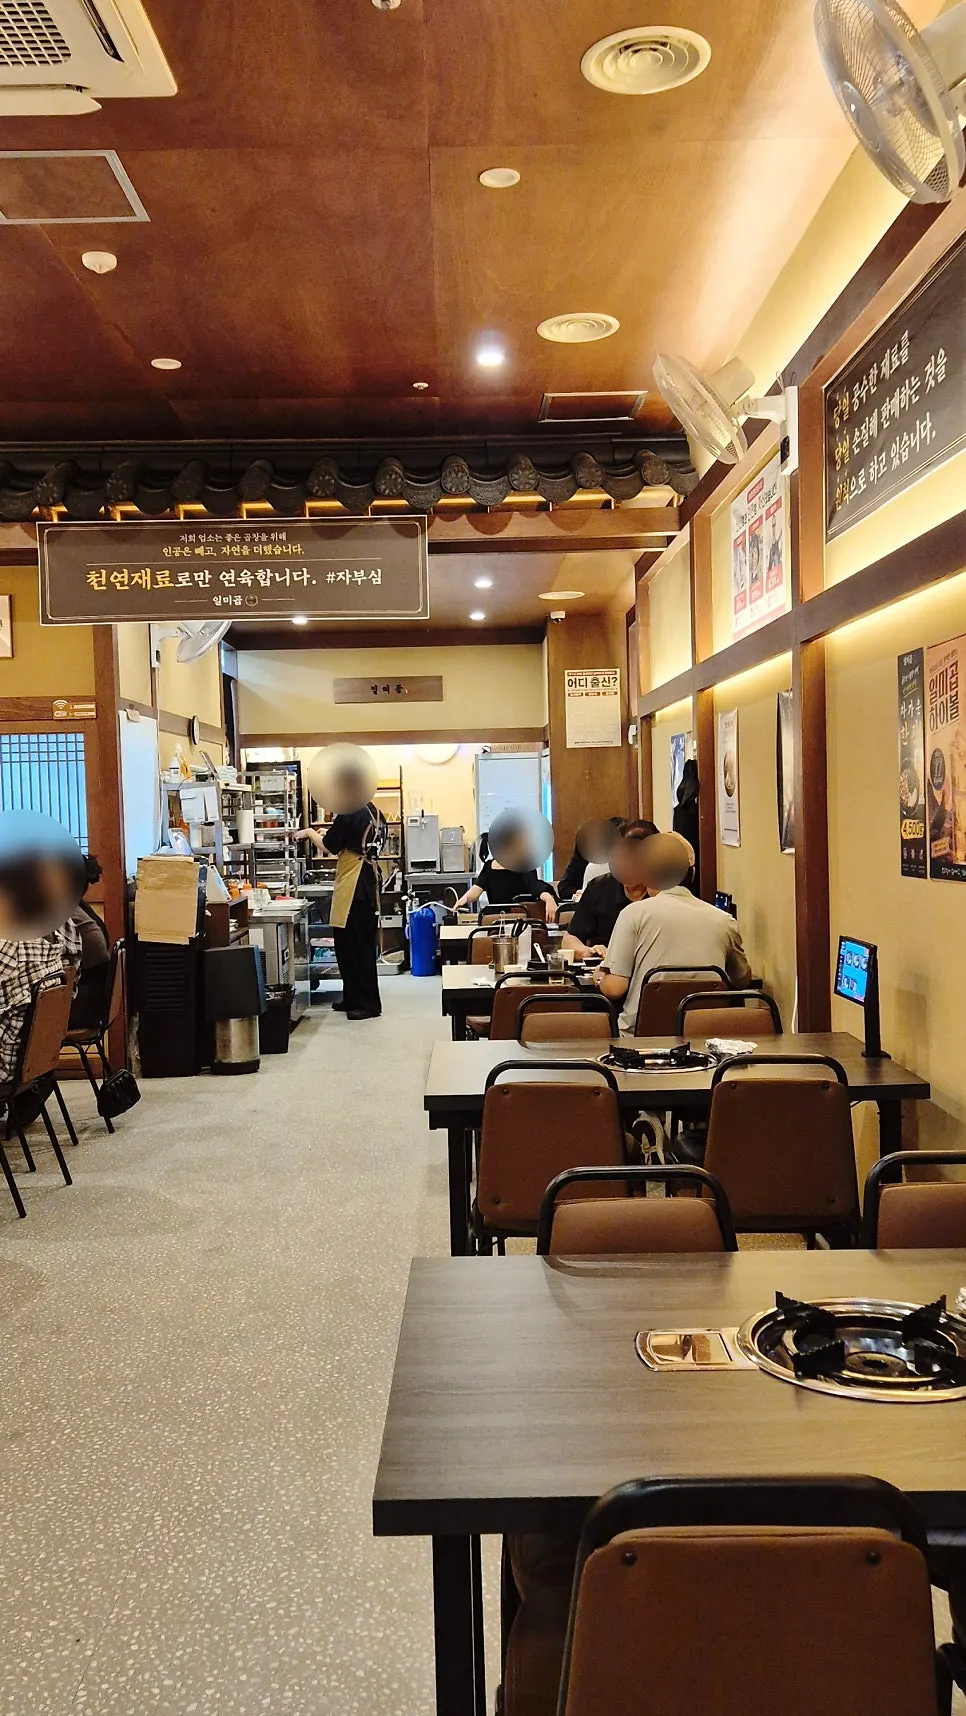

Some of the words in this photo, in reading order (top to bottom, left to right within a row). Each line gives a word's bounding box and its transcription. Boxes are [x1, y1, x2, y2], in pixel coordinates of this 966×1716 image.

[833, 392, 850, 430] 당일
[851, 362, 878, 413] 공수한
[879, 330, 910, 381] 재료를
[834, 436, 850, 470] 당일
[852, 414, 878, 455] 손질해
[880, 374, 921, 430] 판매하는
[924, 346, 948, 393] 것을
[868, 451, 888, 488] 하고
[889, 411, 936, 471] 있습니다.
[162, 545, 192, 557] 인공은
[194, 545, 217, 558] 빼고,
[220, 544, 250, 556] 자연을
[253, 543, 305, 556] 더했습니다.
[179, 533, 196, 544] 저희
[198, 533, 223, 543] 업소는
[224, 533, 242, 543] 좋은
[243, 532, 268, 542] 곱창을
[269, 531, 287, 541] 위해
[86, 567, 212, 591] 천연재료로만
[219, 567, 317, 588] 연육합니다.
[325, 568, 382, 585] #자부심
[212, 595, 243, 606] 일미곱
[567, 677, 588, 689] 어디
[590, 676, 618, 688] 출신?
[929, 660, 959, 706] 일미곱
[929, 689, 960, 732] 하이볼
